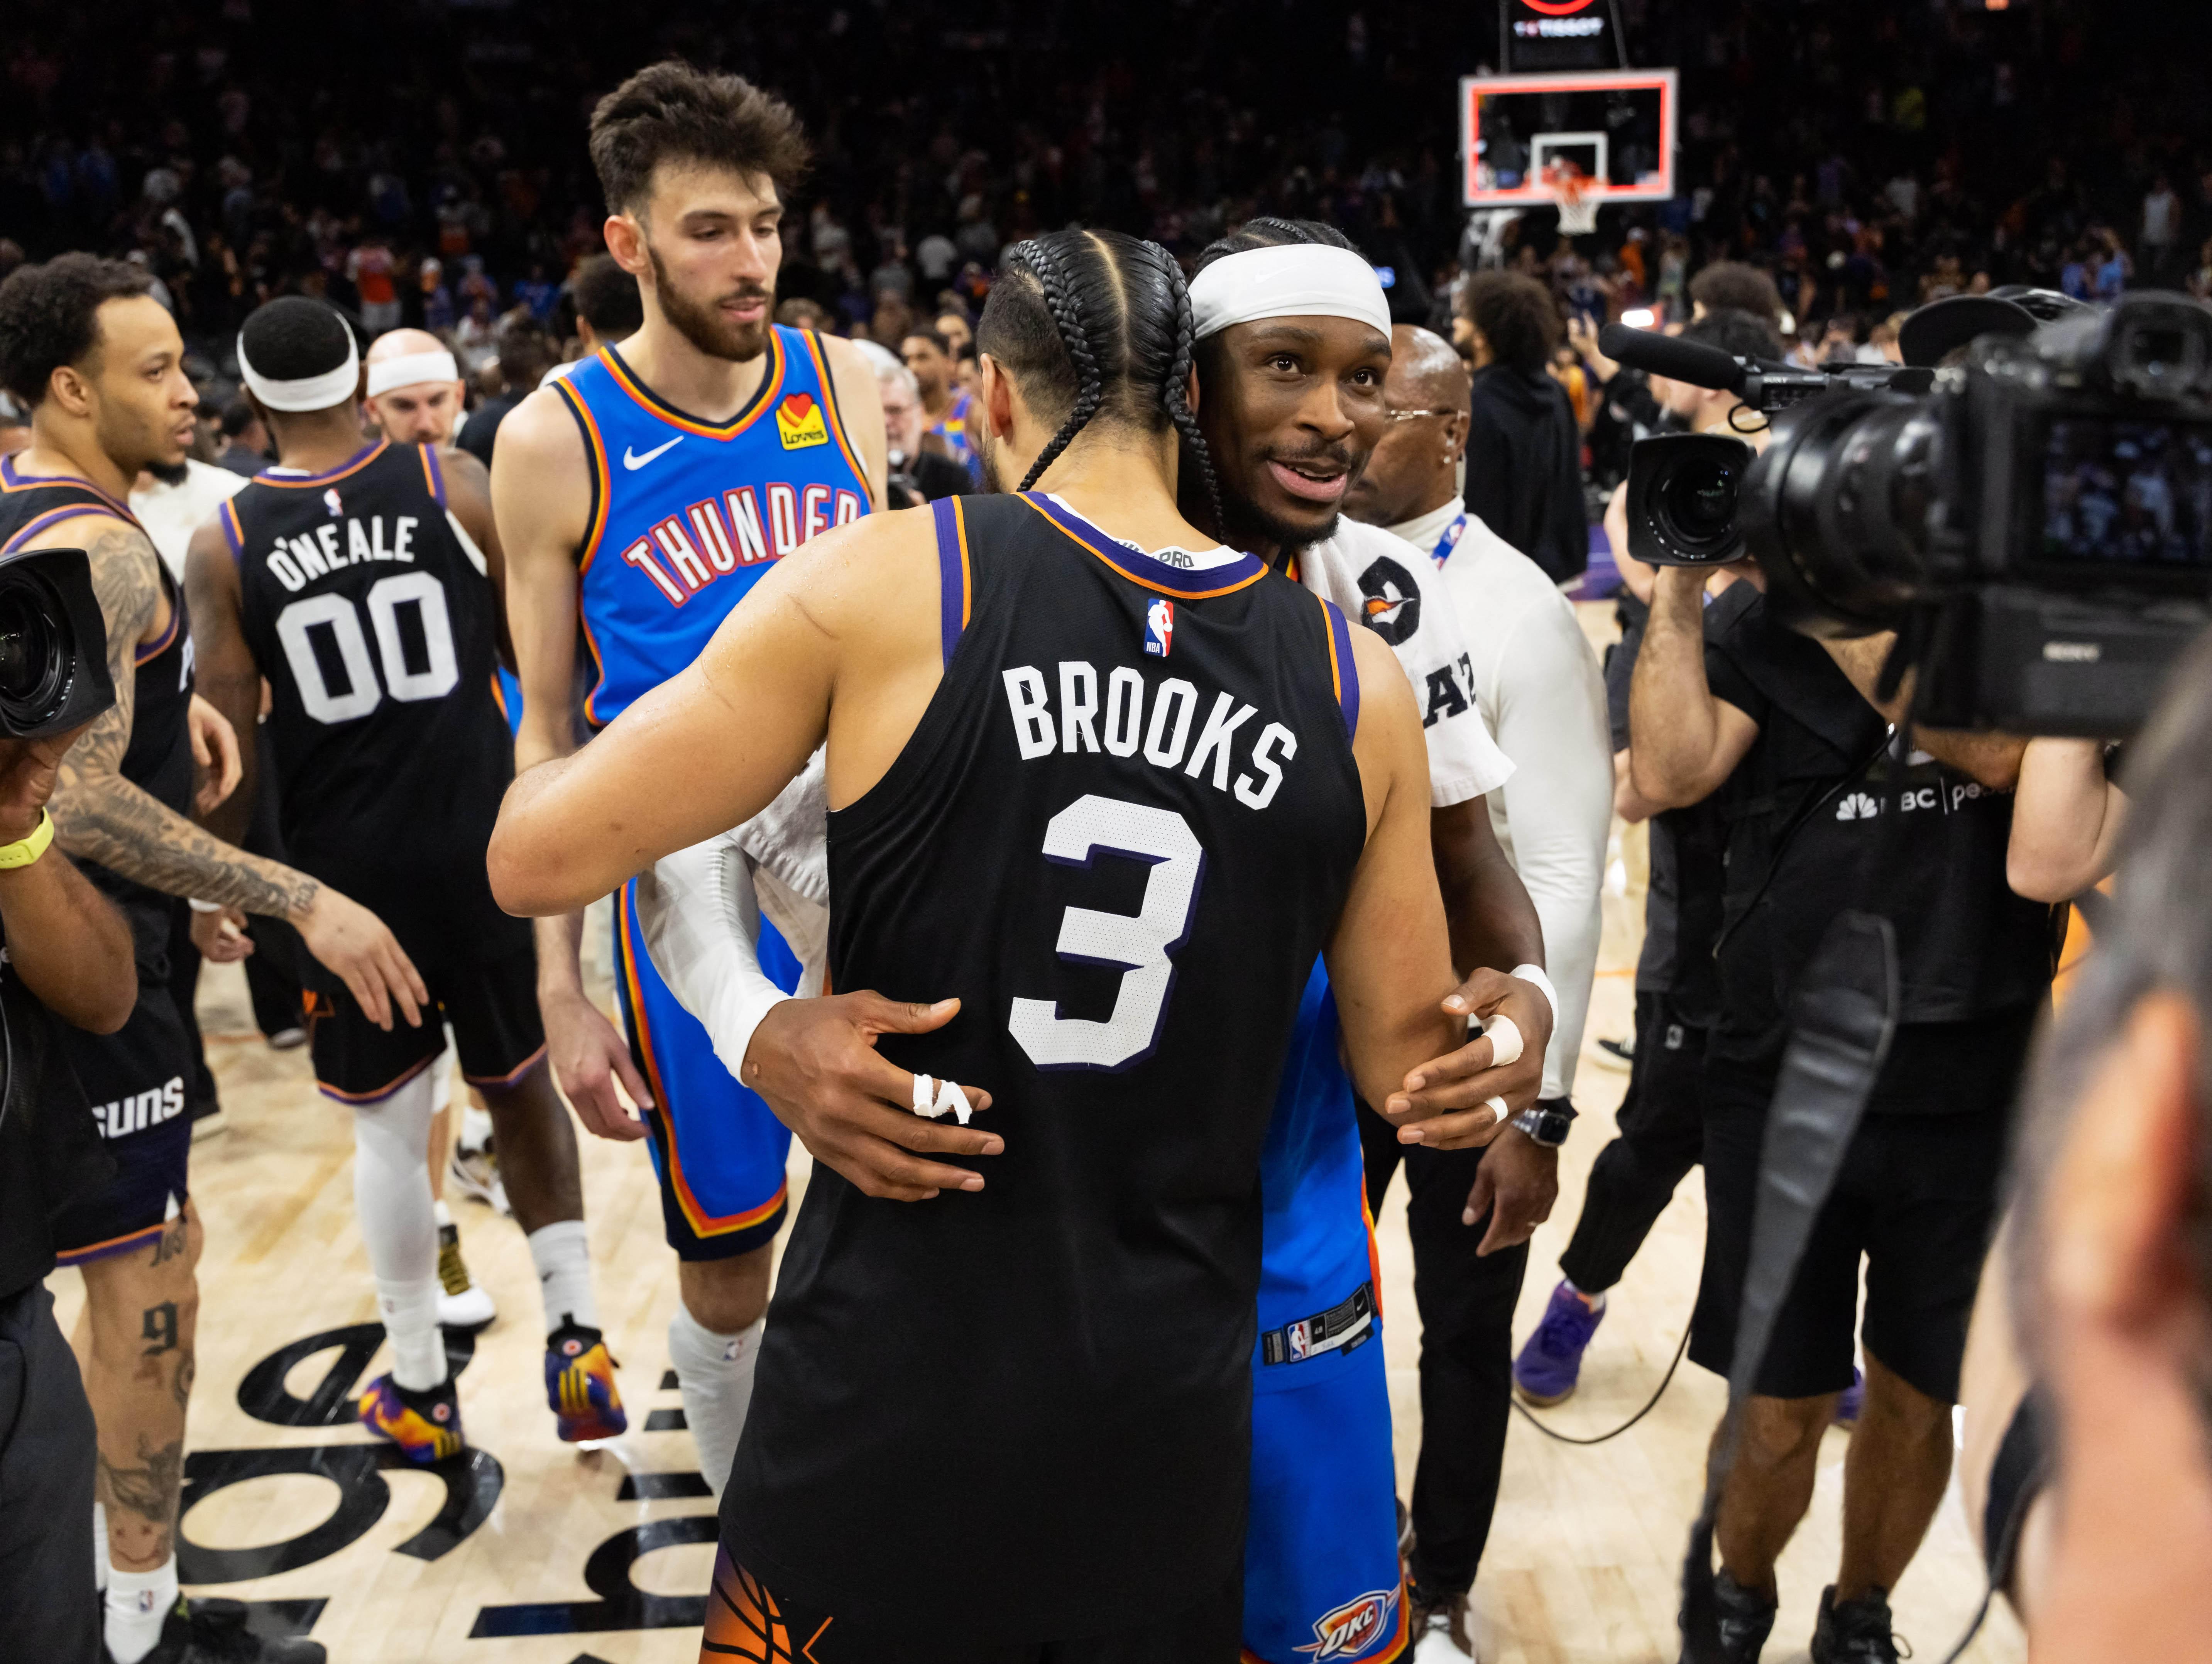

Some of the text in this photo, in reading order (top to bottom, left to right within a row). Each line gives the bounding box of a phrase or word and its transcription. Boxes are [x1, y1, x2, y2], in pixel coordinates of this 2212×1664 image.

[267, 515, 418, 592] O'NEALE
[276, 570, 460, 725] 00
[1146, 641, 1160, 654] NBA
[1003, 661, 1297, 810] BROOKS
[1008, 794, 1206, 1072] 3
